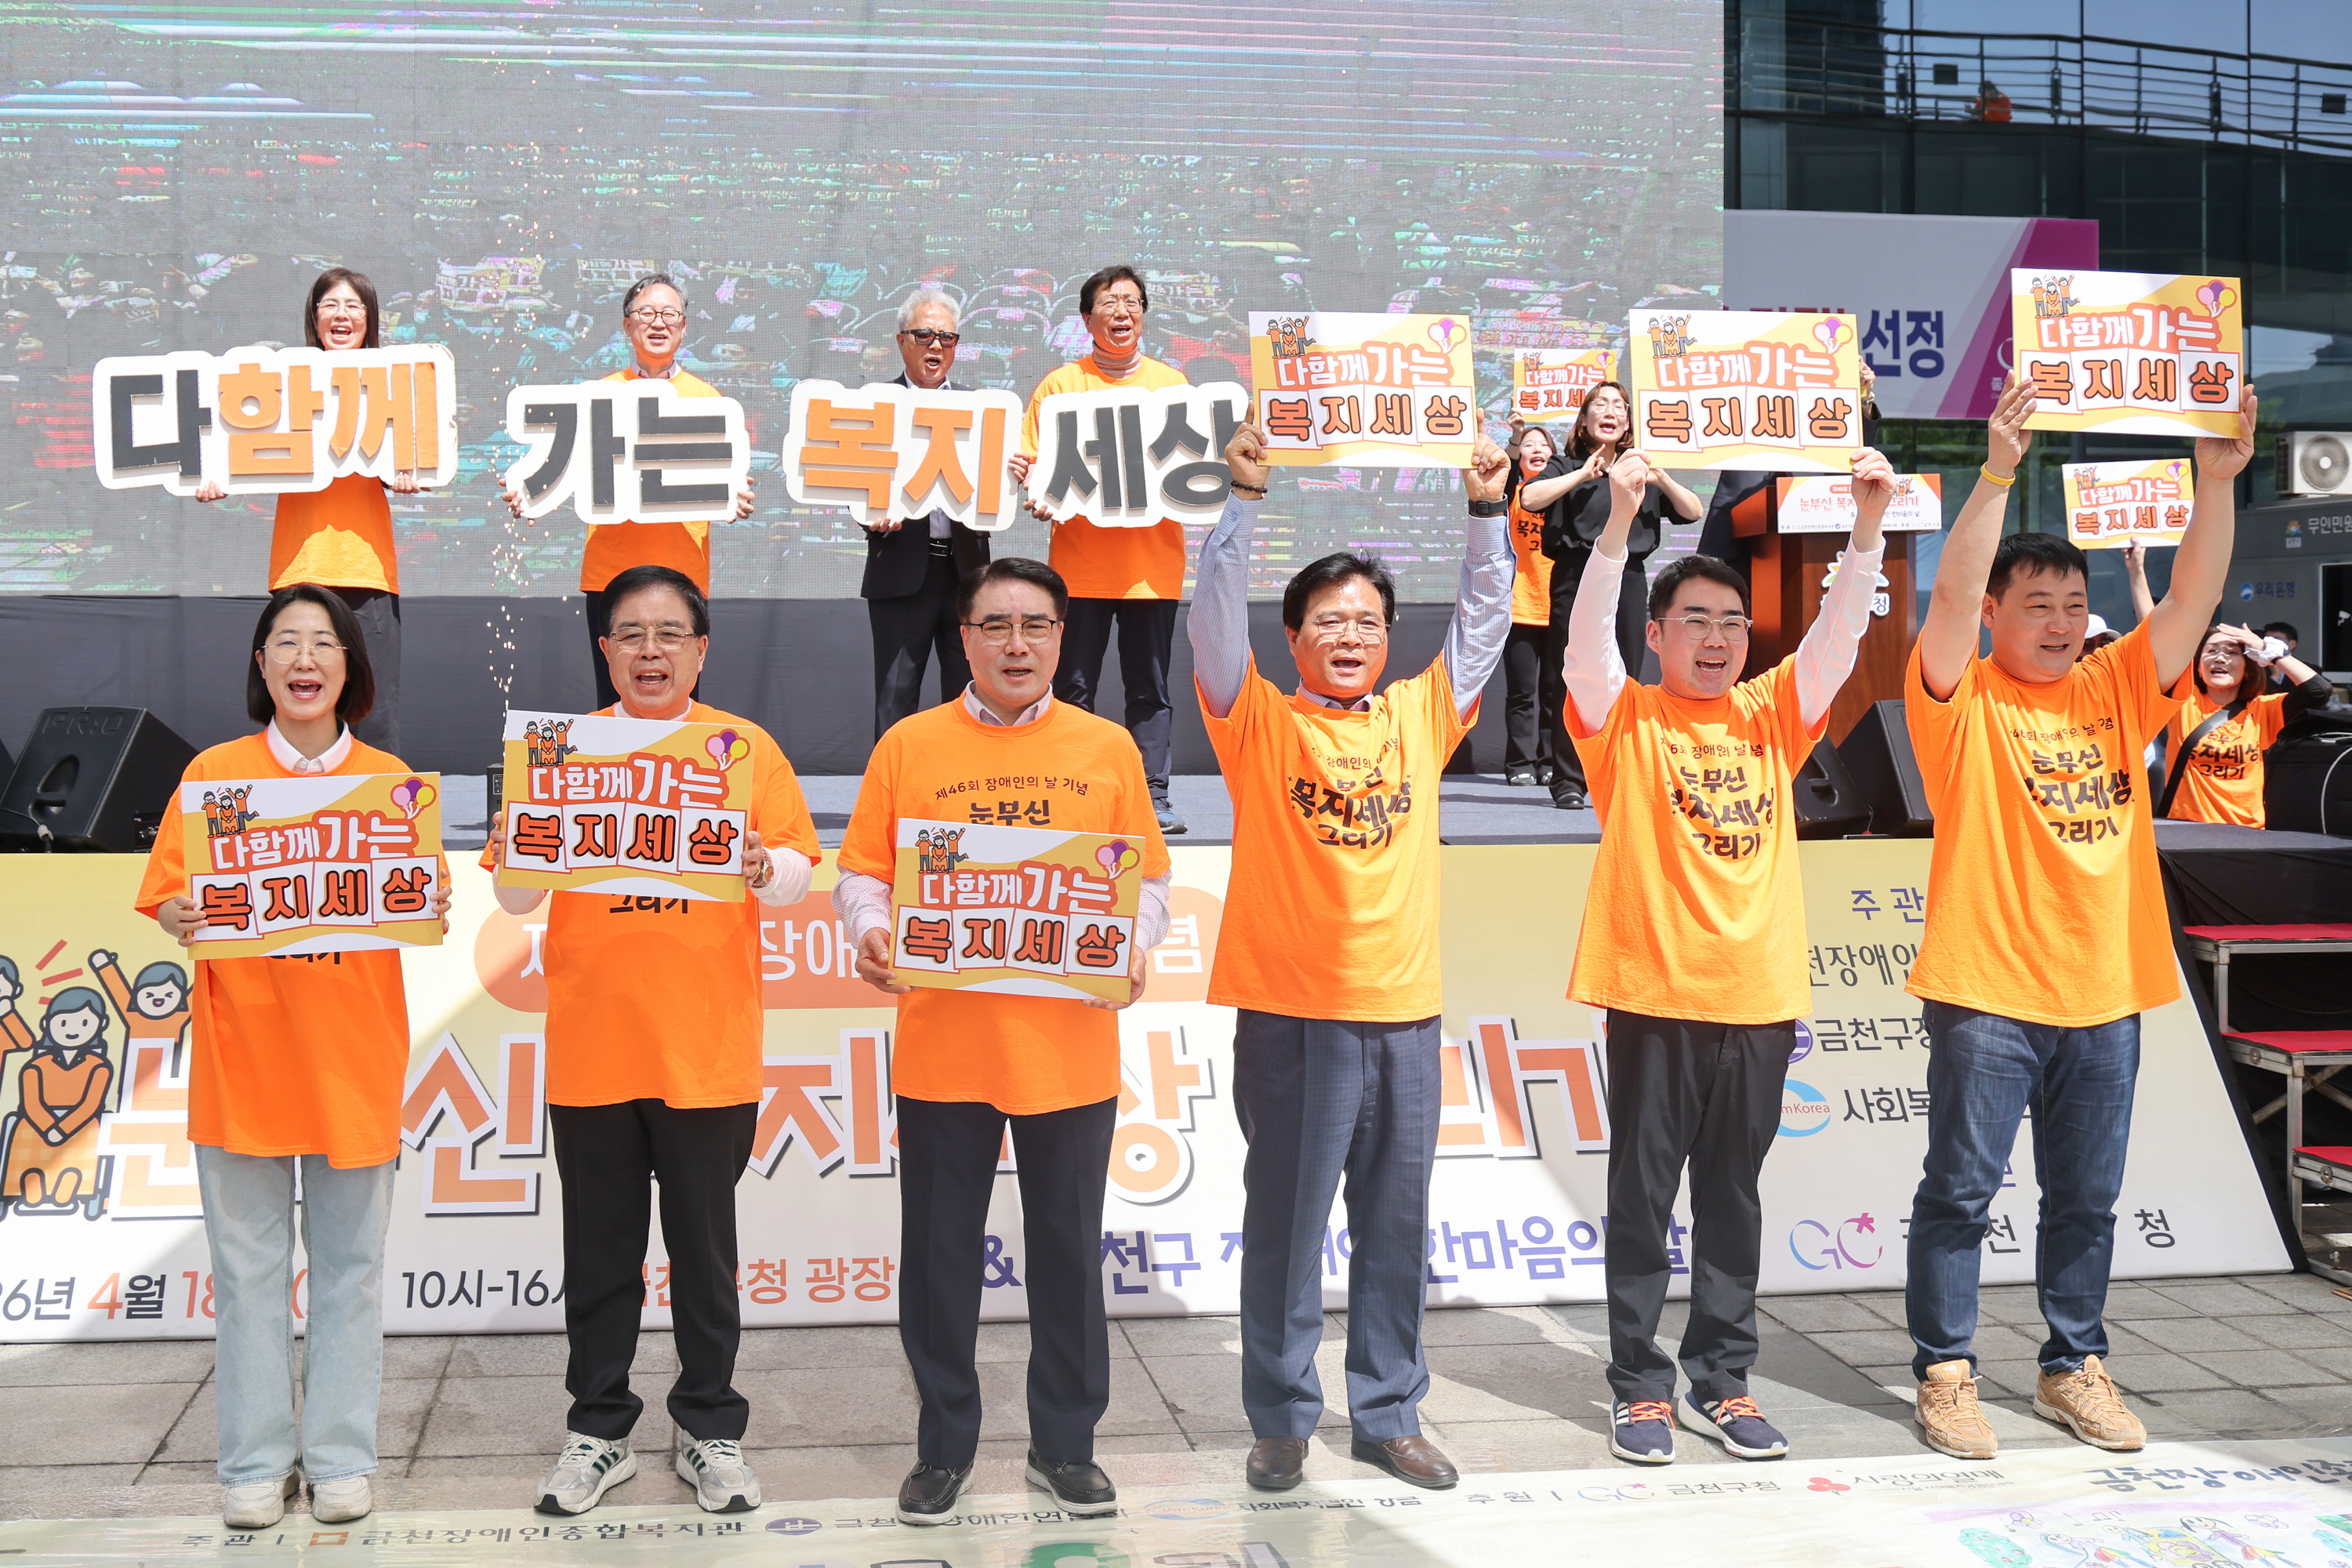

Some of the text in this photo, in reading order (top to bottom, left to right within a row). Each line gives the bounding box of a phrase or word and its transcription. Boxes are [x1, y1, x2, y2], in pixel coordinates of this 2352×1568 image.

[1862, 310, 1944, 378] 선정
[1266, 394, 1466, 439] 복지세상
[1519, 388, 1585, 410] 복지세
[1647, 396, 1852, 443] 복지세상
[110, 363, 1244, 514] 다함께 가는 복지 세상
[1799, 497, 1832, 511] 눈부신
[2031, 743, 2104, 775] 눈부신
[935, 776, 1088, 800] 제46회 장애인의 날 기념
[969, 800, 1051, 826] 눈부신
[2048, 816, 2119, 844] 그리기
[514, 812, 739, 865] 복지세상
[200, 867, 431, 931] 복지세상
[903, 916, 1125, 967] 복지세상
[1101, 1231, 1201, 1294] 천구
[88, 1272, 166, 1319] 4월
[402, 1269, 564, 1309] 10시-16
[806, 1256, 895, 1302] 광장
[1665, 1480, 1781, 1495] 금천구청
